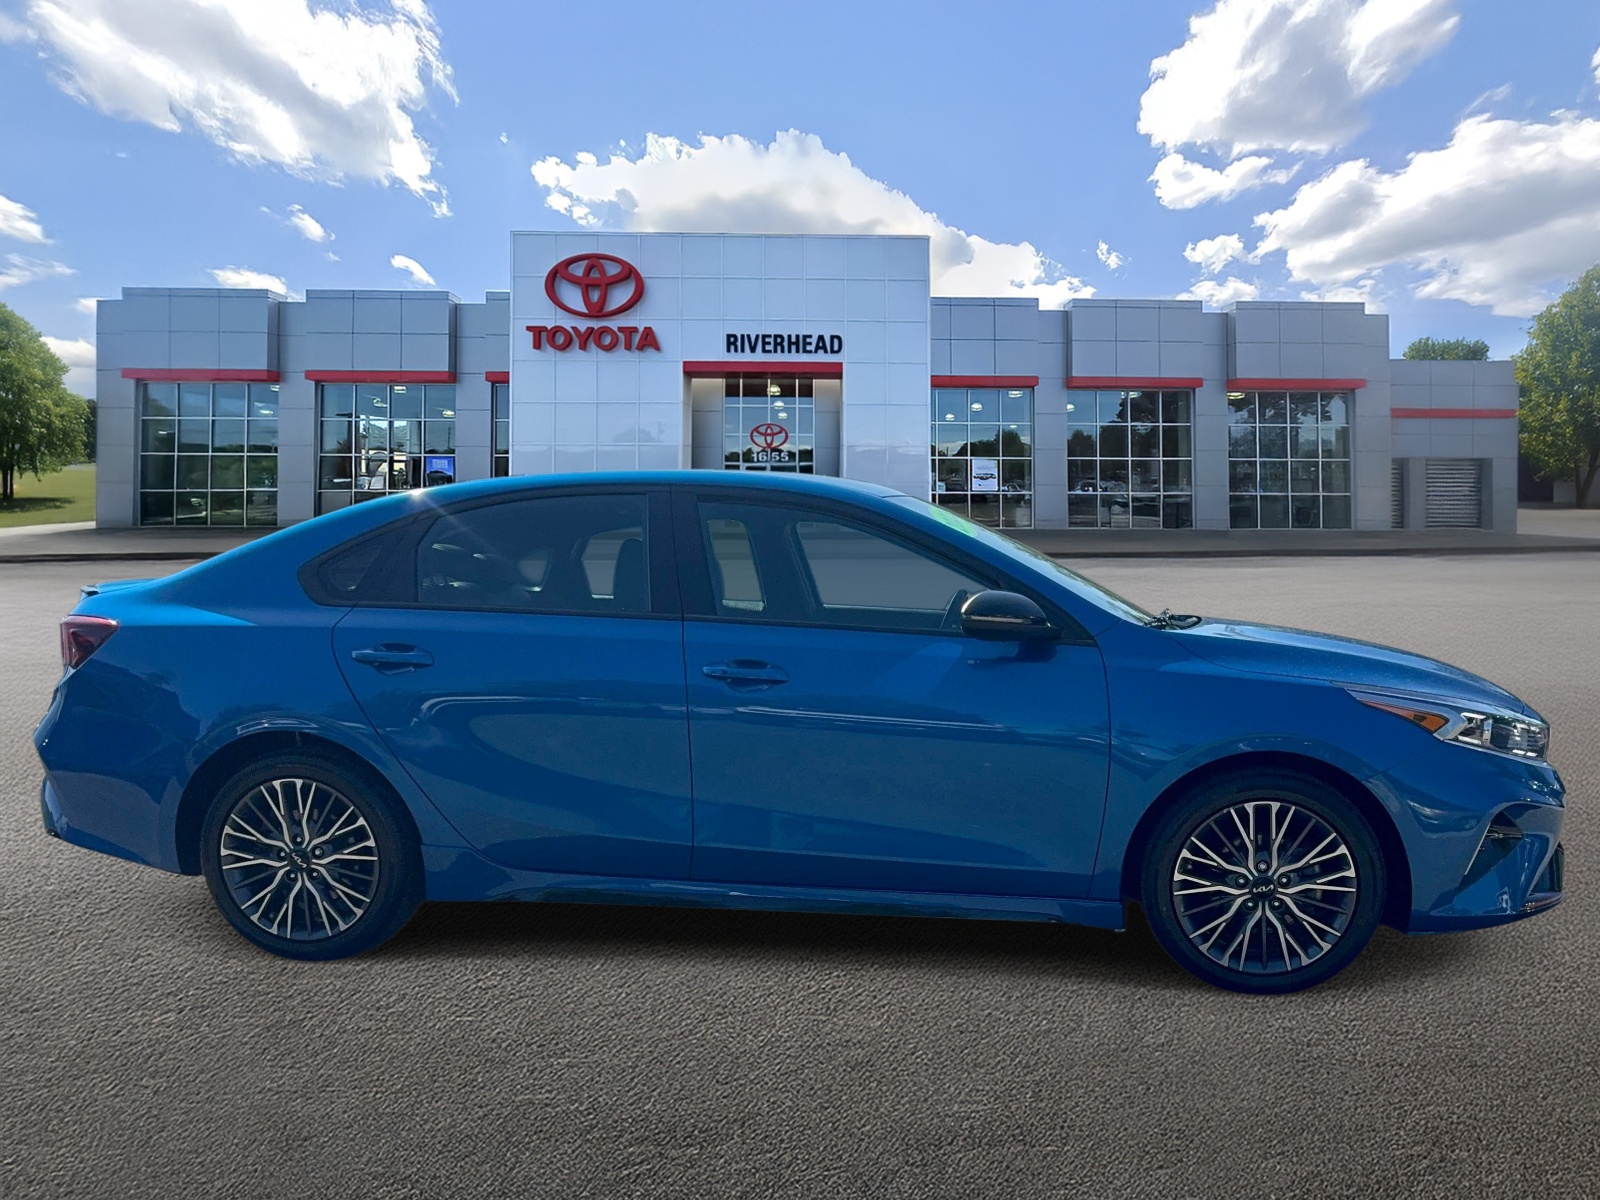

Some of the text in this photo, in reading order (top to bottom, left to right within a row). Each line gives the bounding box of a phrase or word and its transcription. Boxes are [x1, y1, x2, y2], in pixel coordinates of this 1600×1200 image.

[526, 325, 661, 352] TOYOTA
[725, 333, 843, 354] RIVERHEAD
[751, 451, 789, 462] 1655
[1252, 884, 1275, 893] KIA
